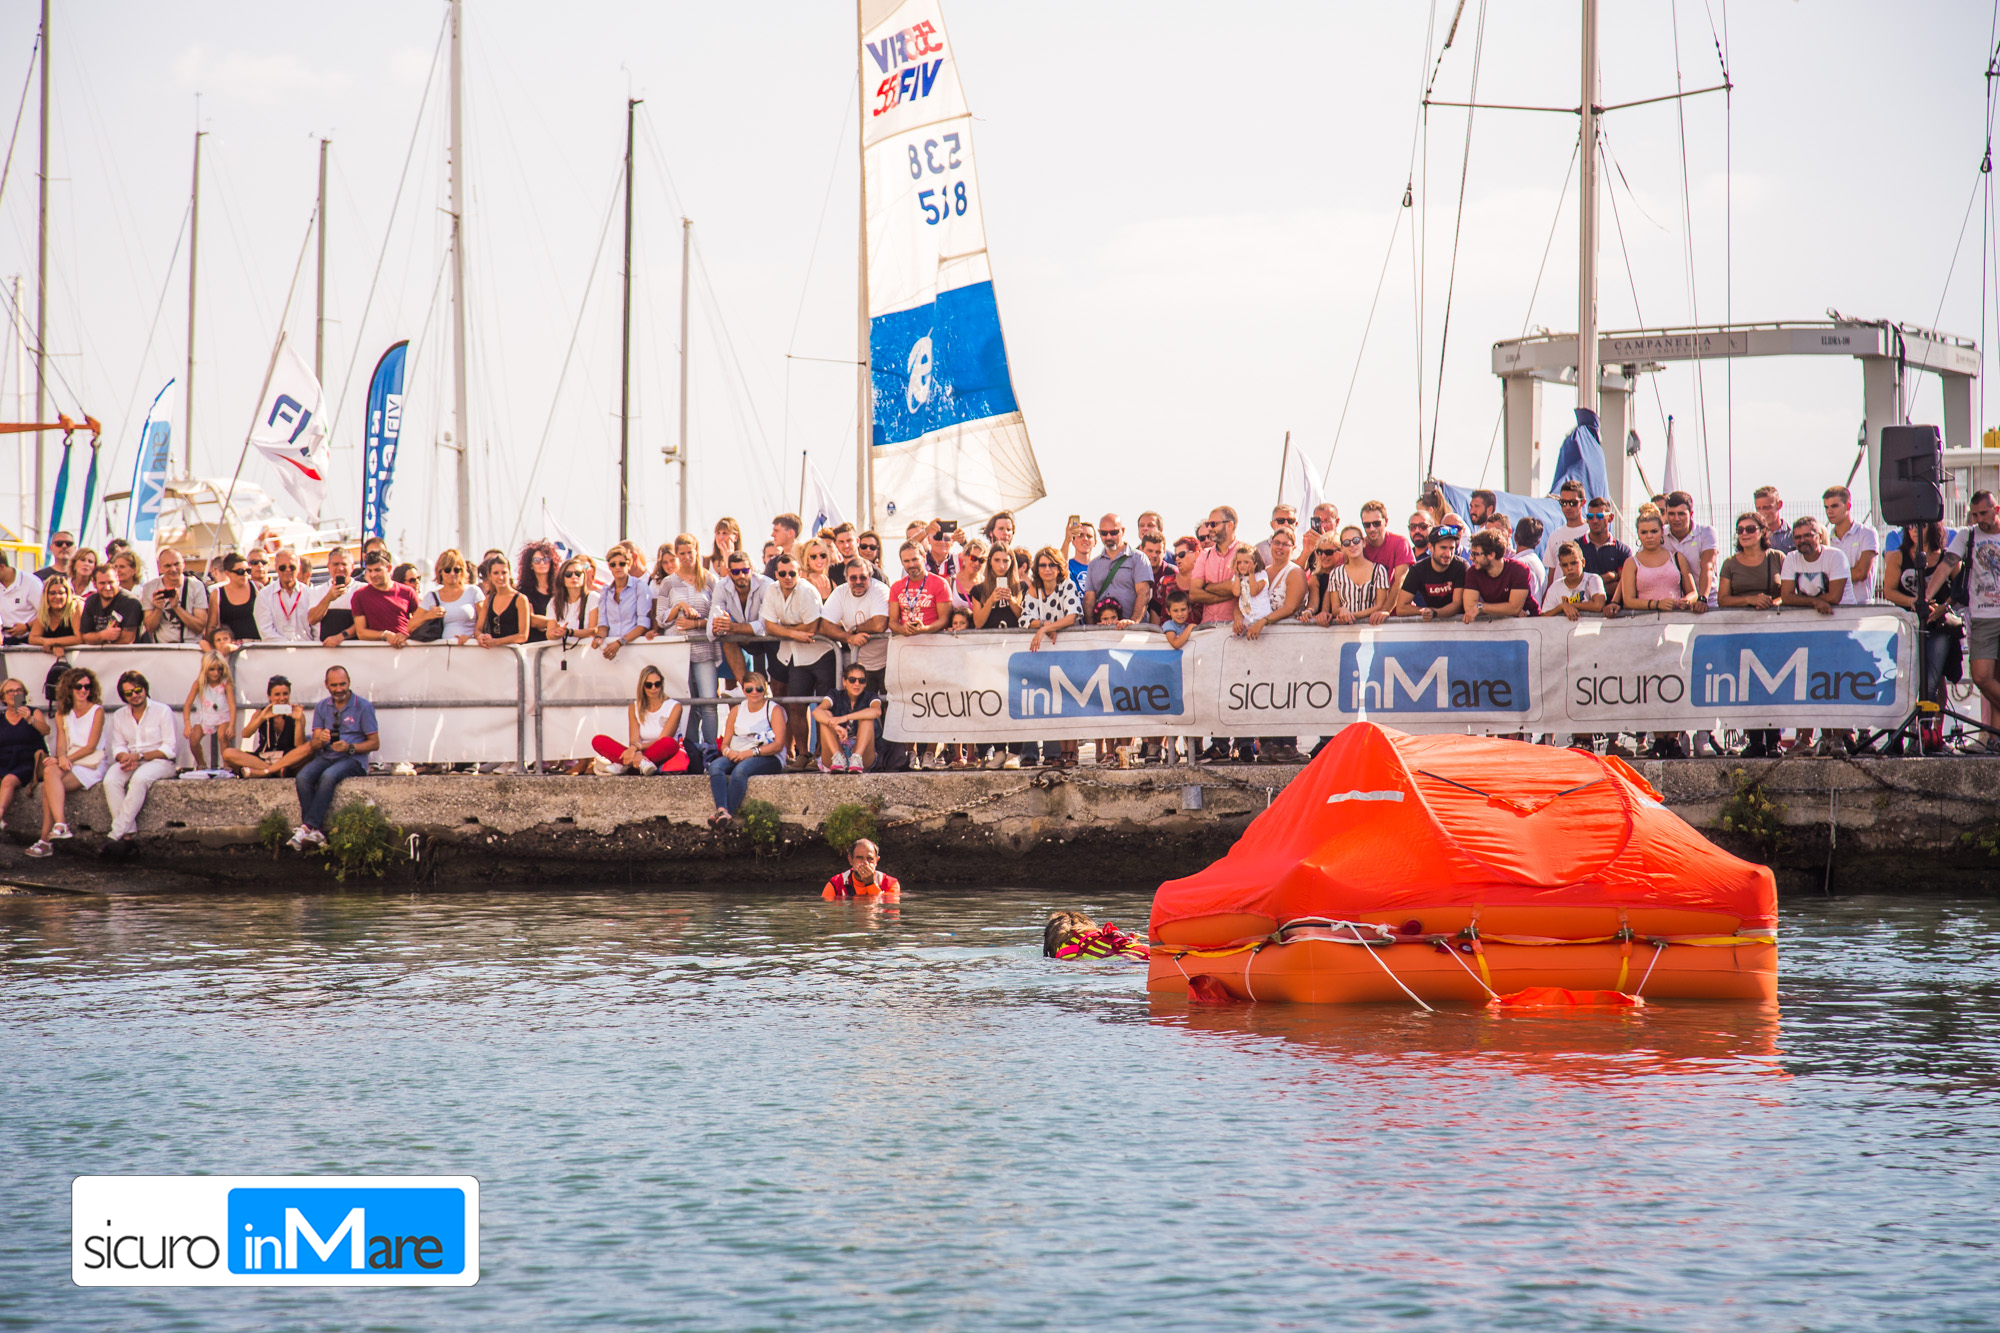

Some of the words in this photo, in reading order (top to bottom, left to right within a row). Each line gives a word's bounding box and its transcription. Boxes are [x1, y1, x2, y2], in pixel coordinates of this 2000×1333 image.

[911, 680, 1003, 718] sicuro
[1021, 664, 1171, 716] inMare
[1228, 669, 1333, 711] sicuro
[1352, 656, 1512, 709] inMare
[1576, 662, 1685, 706] sicuro
[1705, 647, 1876, 703] inMare
